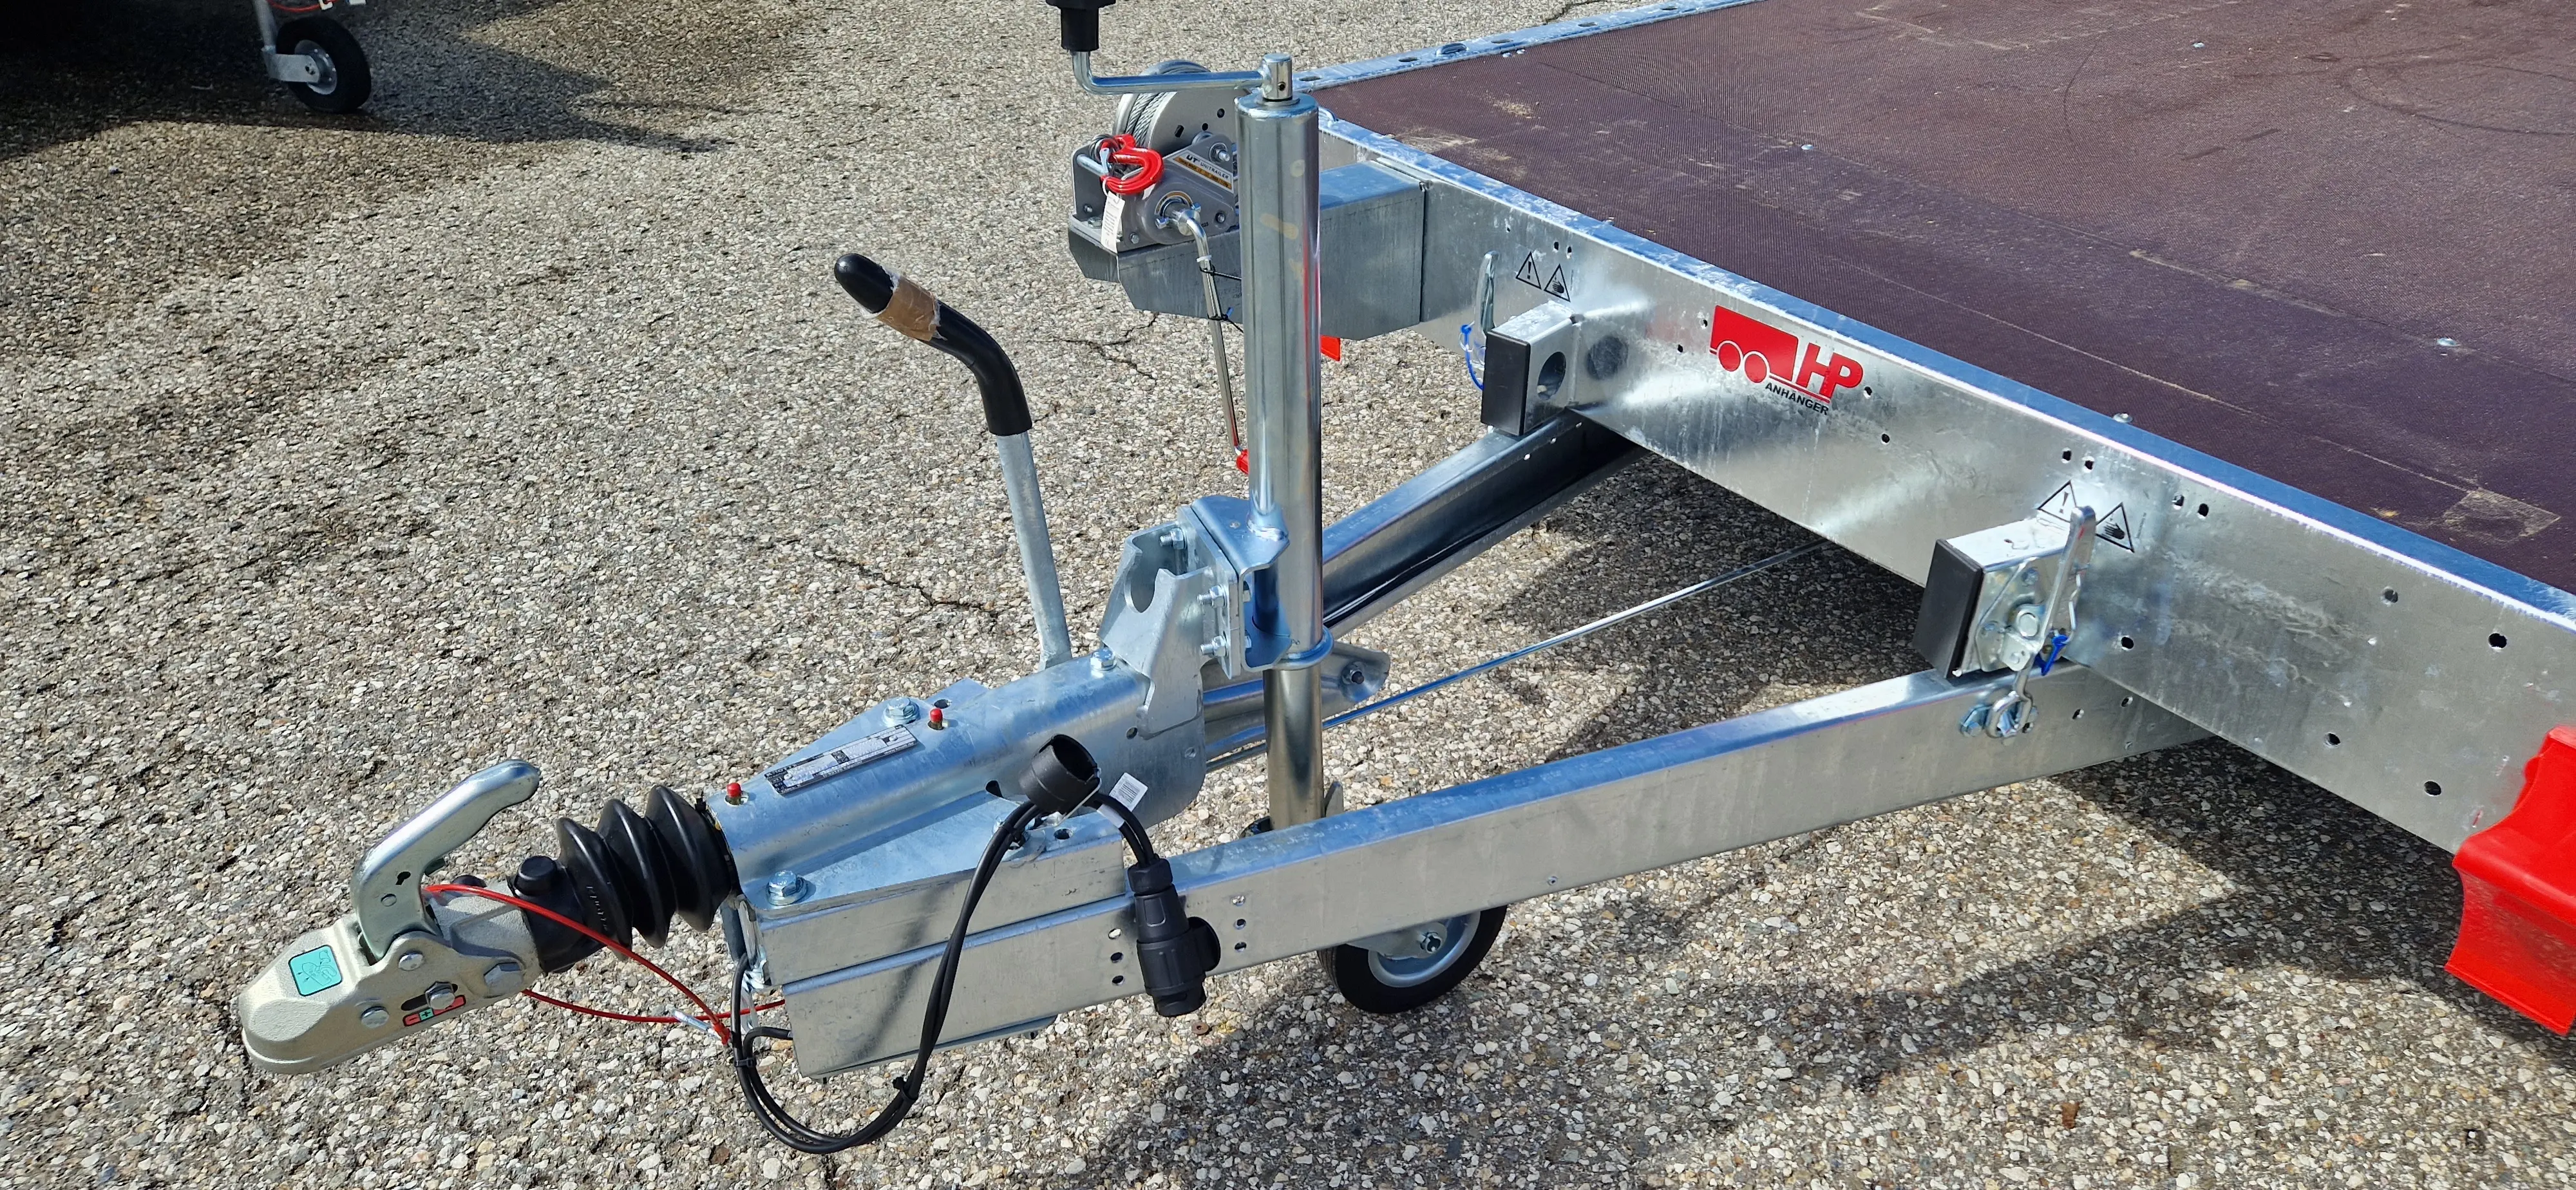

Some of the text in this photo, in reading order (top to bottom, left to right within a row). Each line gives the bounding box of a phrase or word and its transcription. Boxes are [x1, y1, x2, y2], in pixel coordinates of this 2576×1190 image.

[1186, 155, 1198, 163] UT
[1200, 162, 1229, 179] UNITRAILER
[1795, 342, 1863, 399] HP
[1765, 382, 1829, 415] ANHÄNGER
